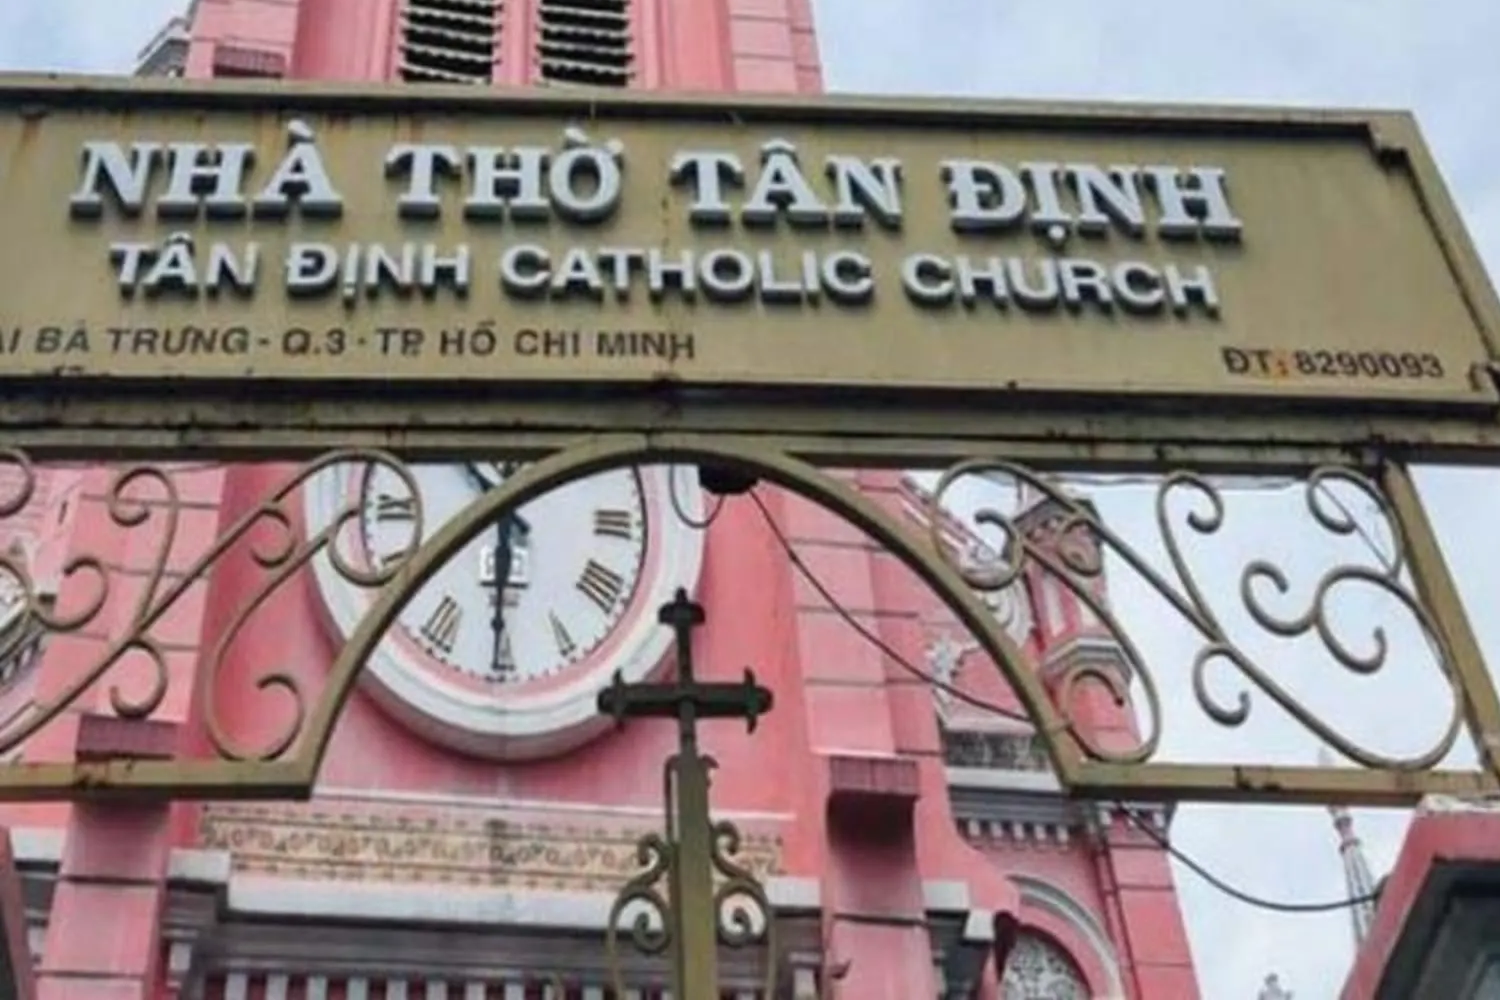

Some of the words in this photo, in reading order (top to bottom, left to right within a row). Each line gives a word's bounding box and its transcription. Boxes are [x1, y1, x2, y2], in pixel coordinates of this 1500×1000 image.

[70, 119, 344, 217] NHÀ
[385, 127, 624, 222] THỜ
[671, 139, 902, 229] TÂN
[939, 158, 1243, 246] ĐỊNH
[110, 231, 257, 296] TÂN
[286, 241, 469, 305] ĐỊNH
[502, 244, 874, 305] CATHOLIC
[902, 253, 1219, 316] CHURCH
[596, 331, 696, 362] MINH
